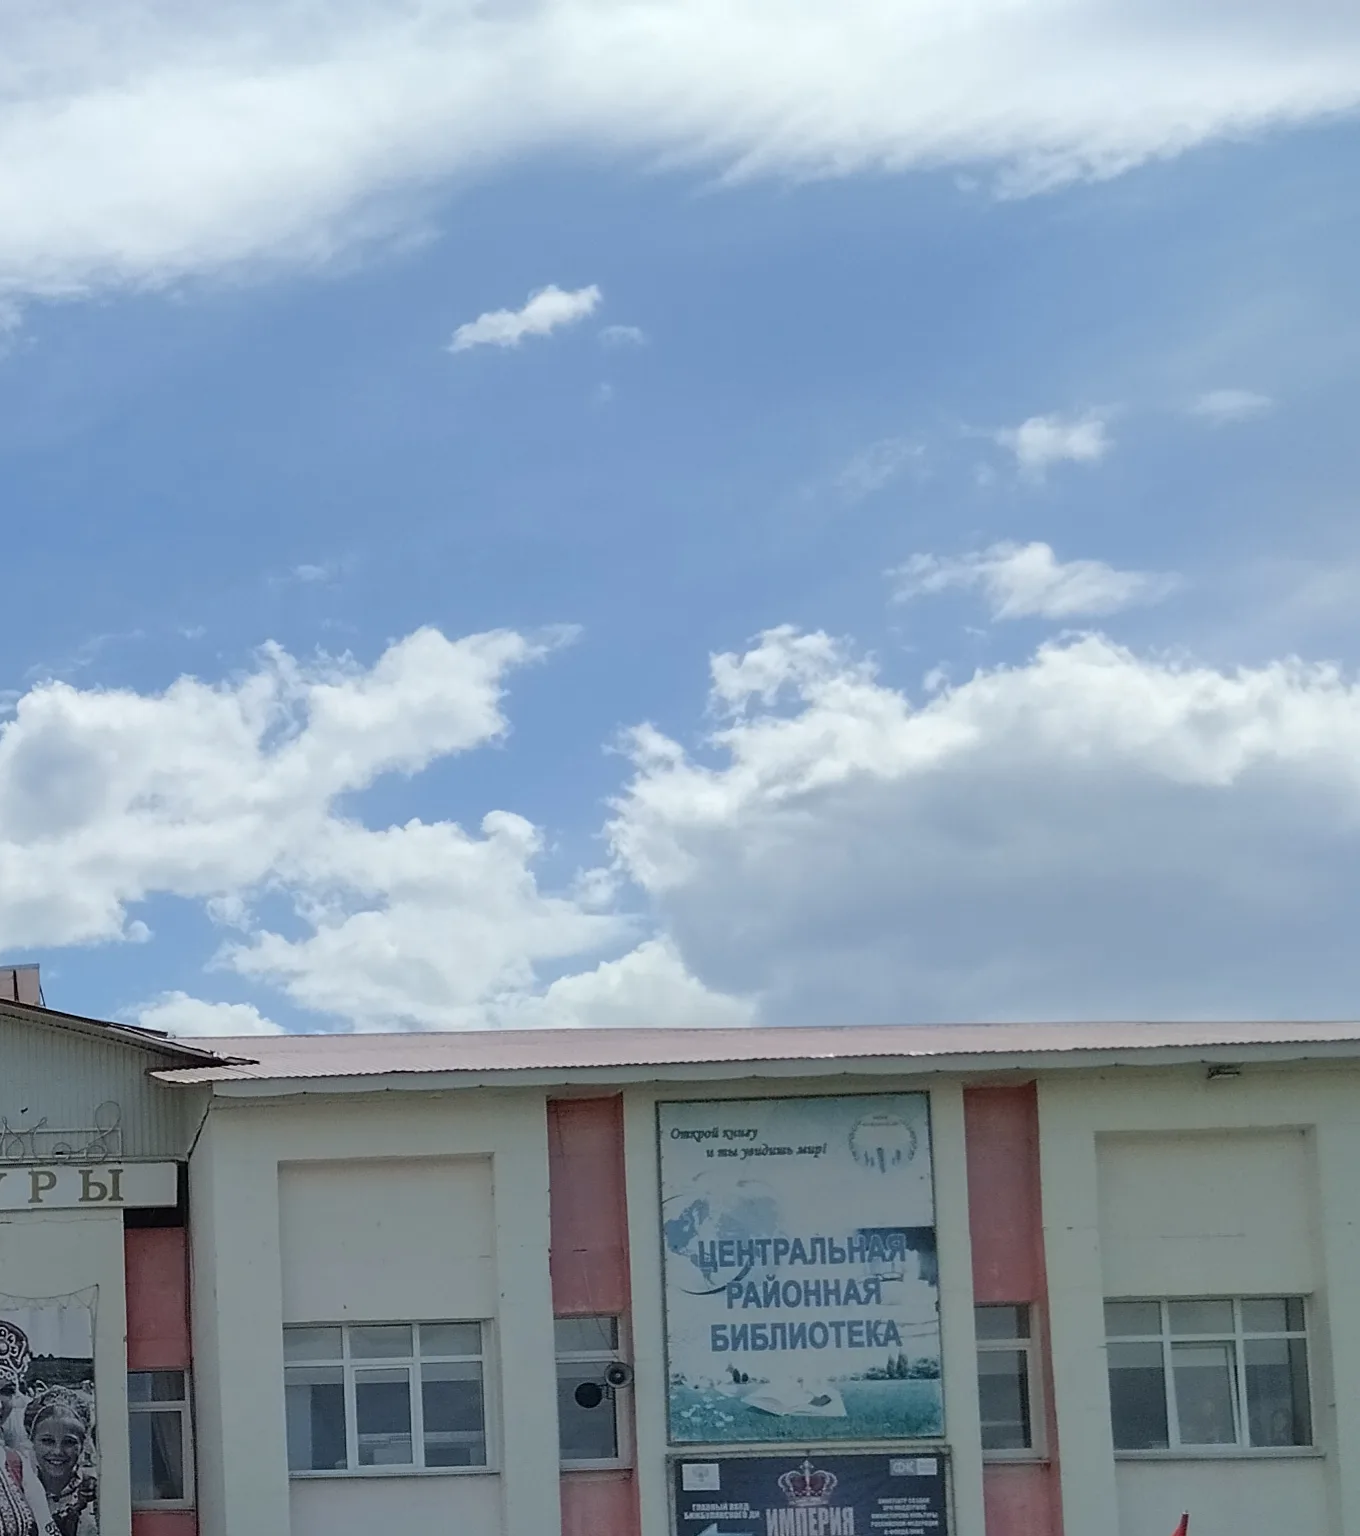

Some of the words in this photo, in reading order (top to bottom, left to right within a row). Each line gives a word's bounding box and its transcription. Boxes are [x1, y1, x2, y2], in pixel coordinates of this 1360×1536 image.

[706, 1149, 714, 1158] и
[718, 1147, 738, 1158] ты
[698, 1233, 906, 1273] ЦЕНТРАЛЬНАЯ
[726, 1273, 882, 1310] РАЙОННАЯ
[711, 1319, 903, 1352] БИБЛИОТЕКА
[766, 1507, 855, 1536] ИМПЕРИЯ
